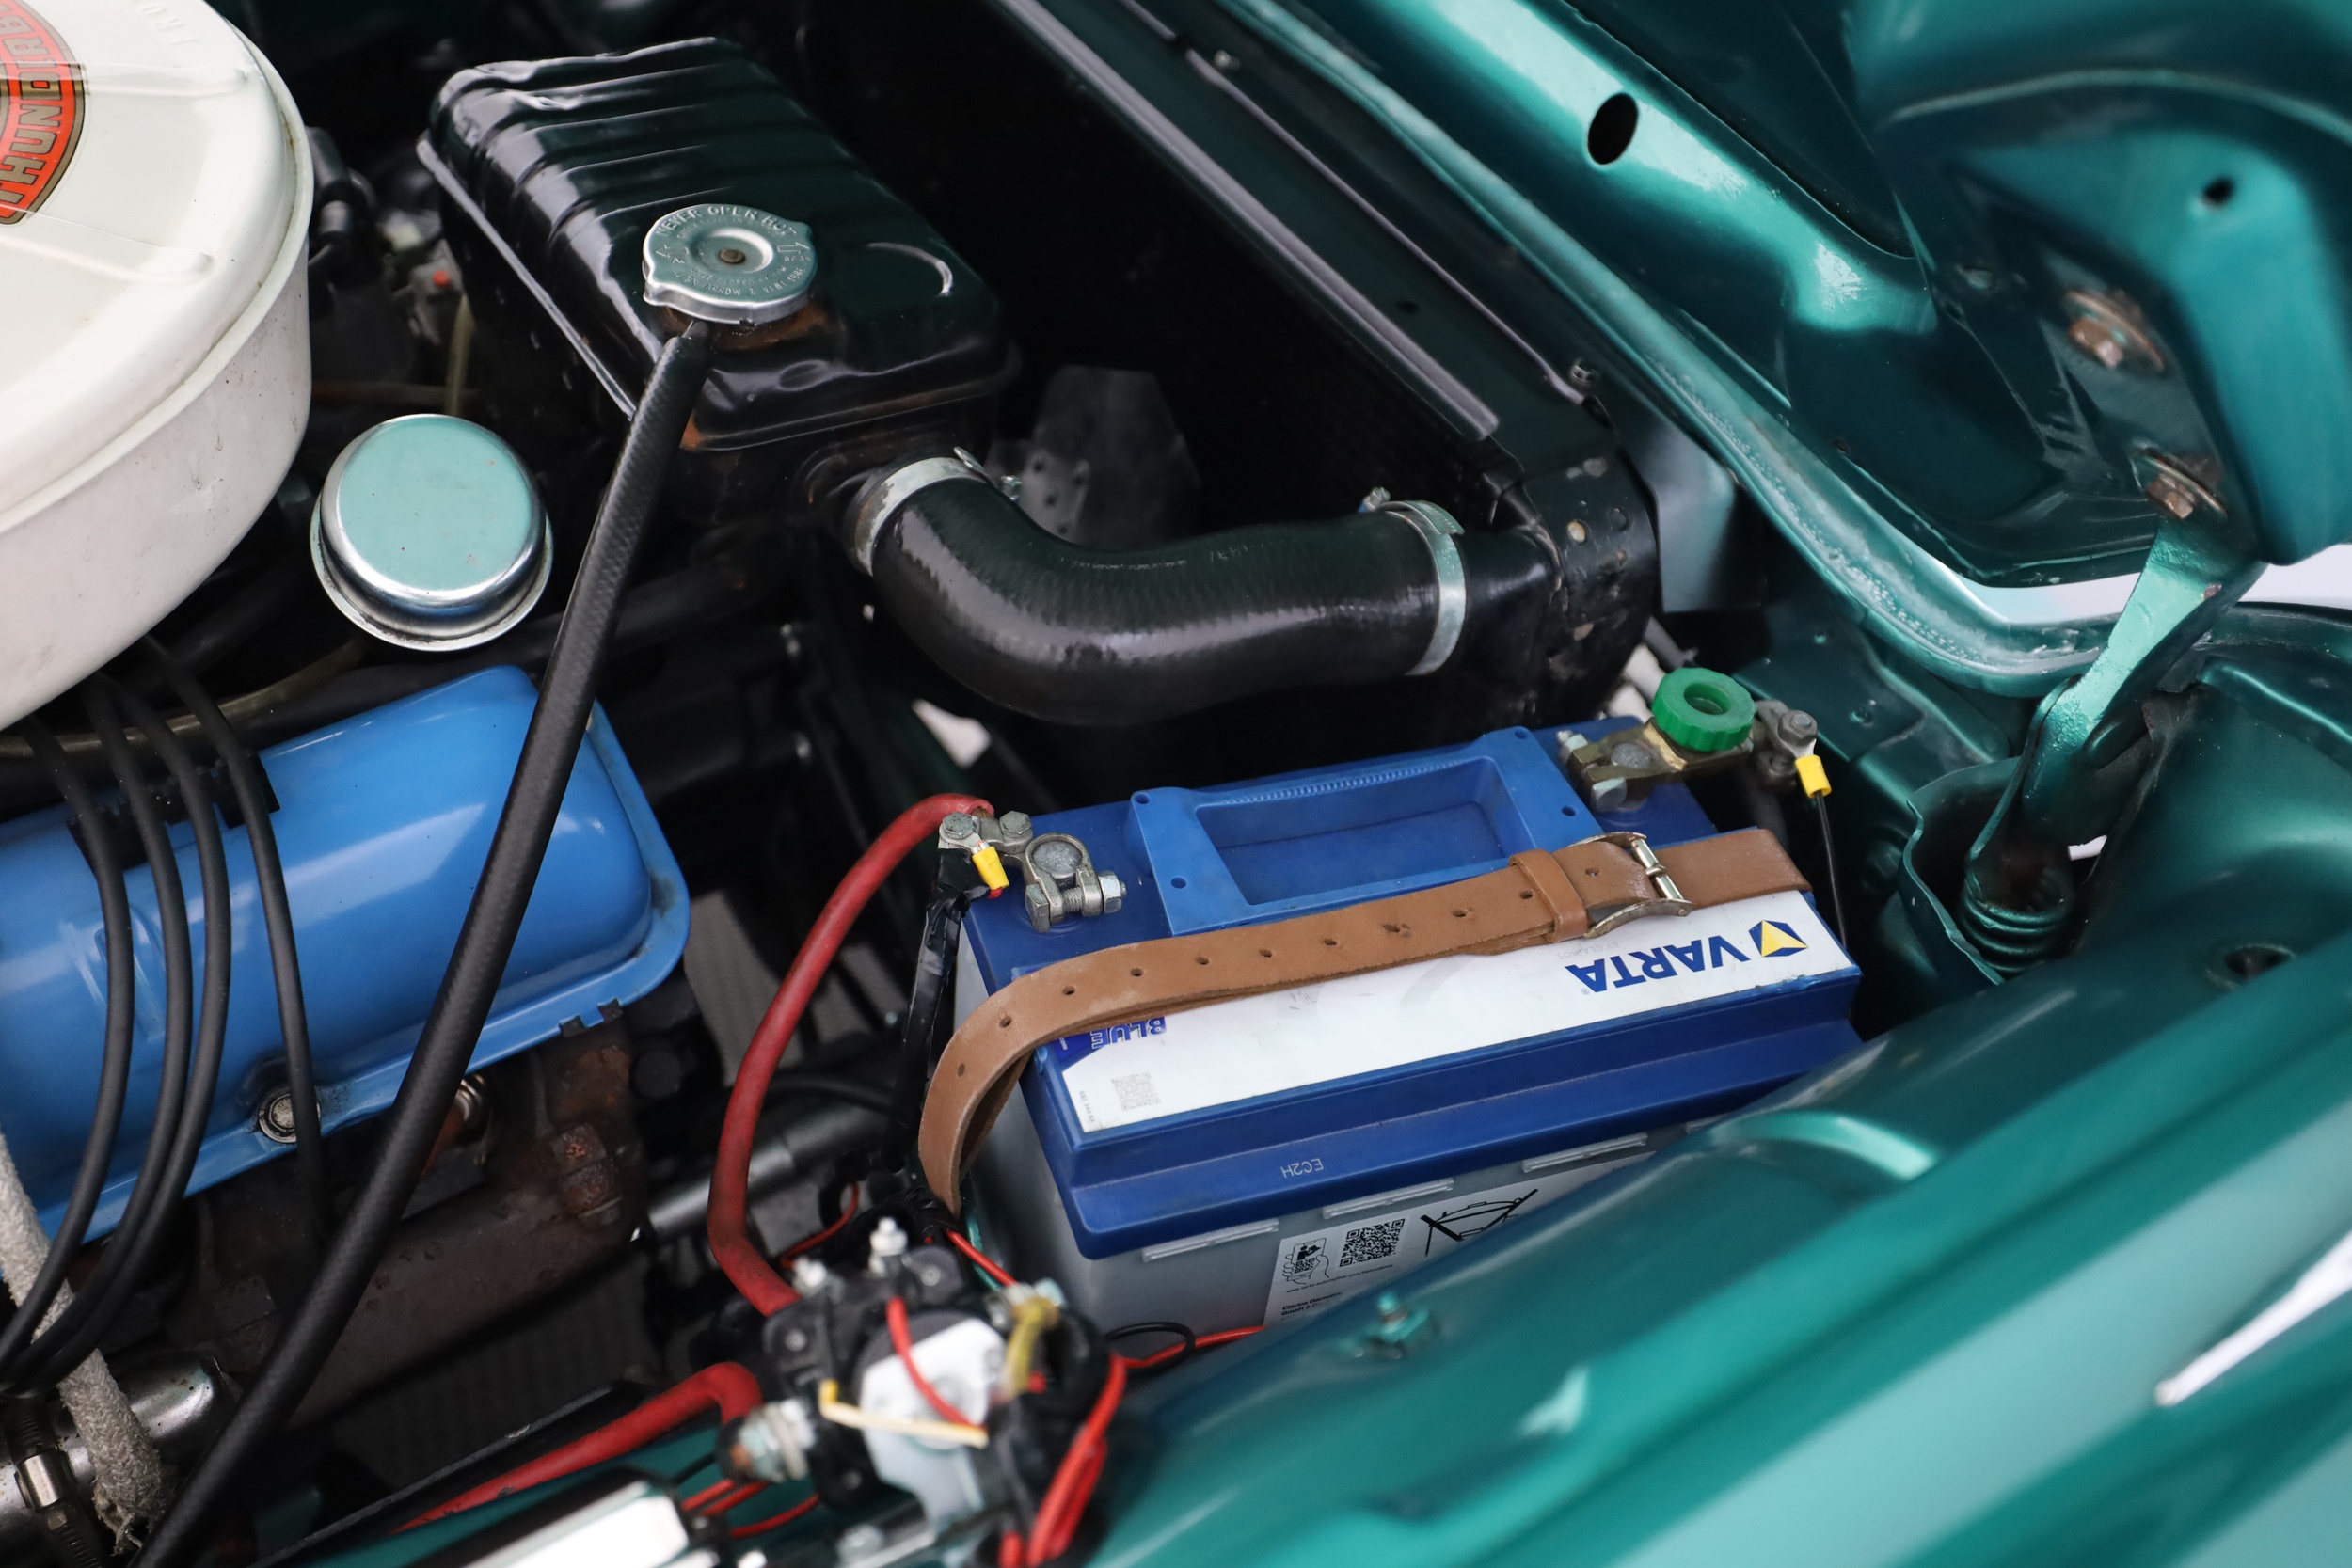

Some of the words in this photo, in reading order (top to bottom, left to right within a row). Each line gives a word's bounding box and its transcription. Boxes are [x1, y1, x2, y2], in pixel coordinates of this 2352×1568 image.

[656, 209, 702, 236] NEVER
[707, 205, 757, 220] OPEN
[762, 215, 798, 235] HOT
[705, 283, 741, 296] ARROW
[1565, 935, 1751, 993] VARTA
[1090, 1017, 1167, 1050] BLUE
[1280, 1158, 1324, 1178] EC2H
